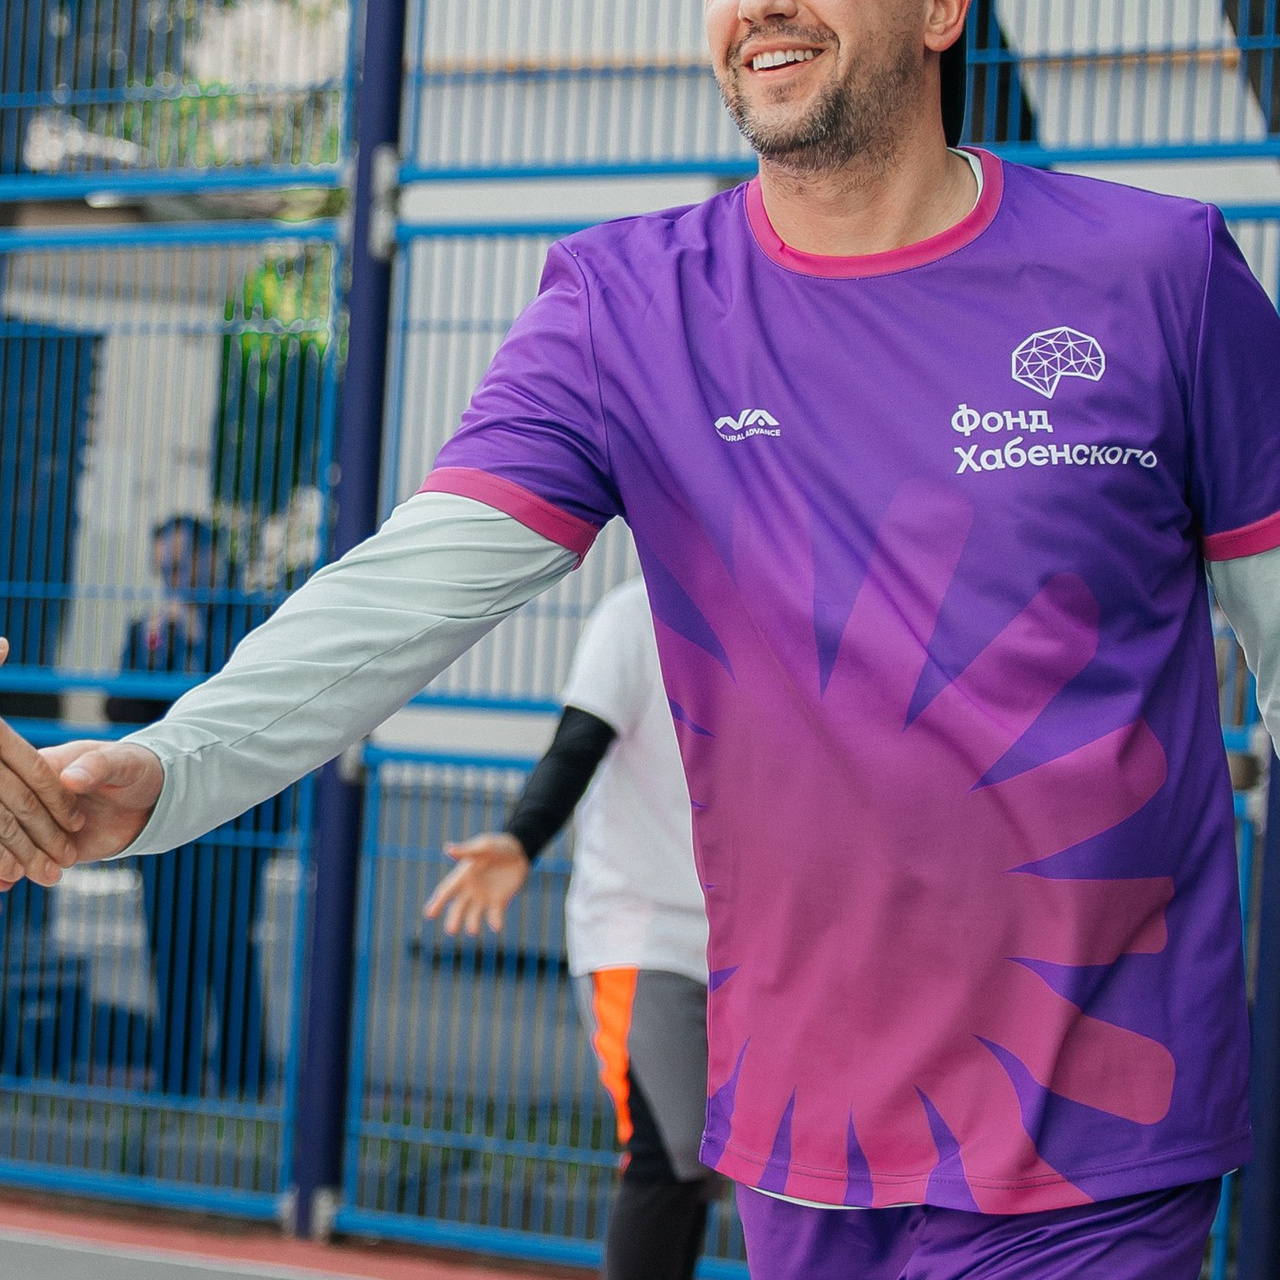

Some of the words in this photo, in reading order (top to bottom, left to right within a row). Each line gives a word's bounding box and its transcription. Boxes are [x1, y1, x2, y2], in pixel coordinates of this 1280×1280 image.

[745, 427, 781, 437] ADVANCE
[951, 403, 1053, 437] Фонд
[954, 436, 1157, 475] Хабенского
